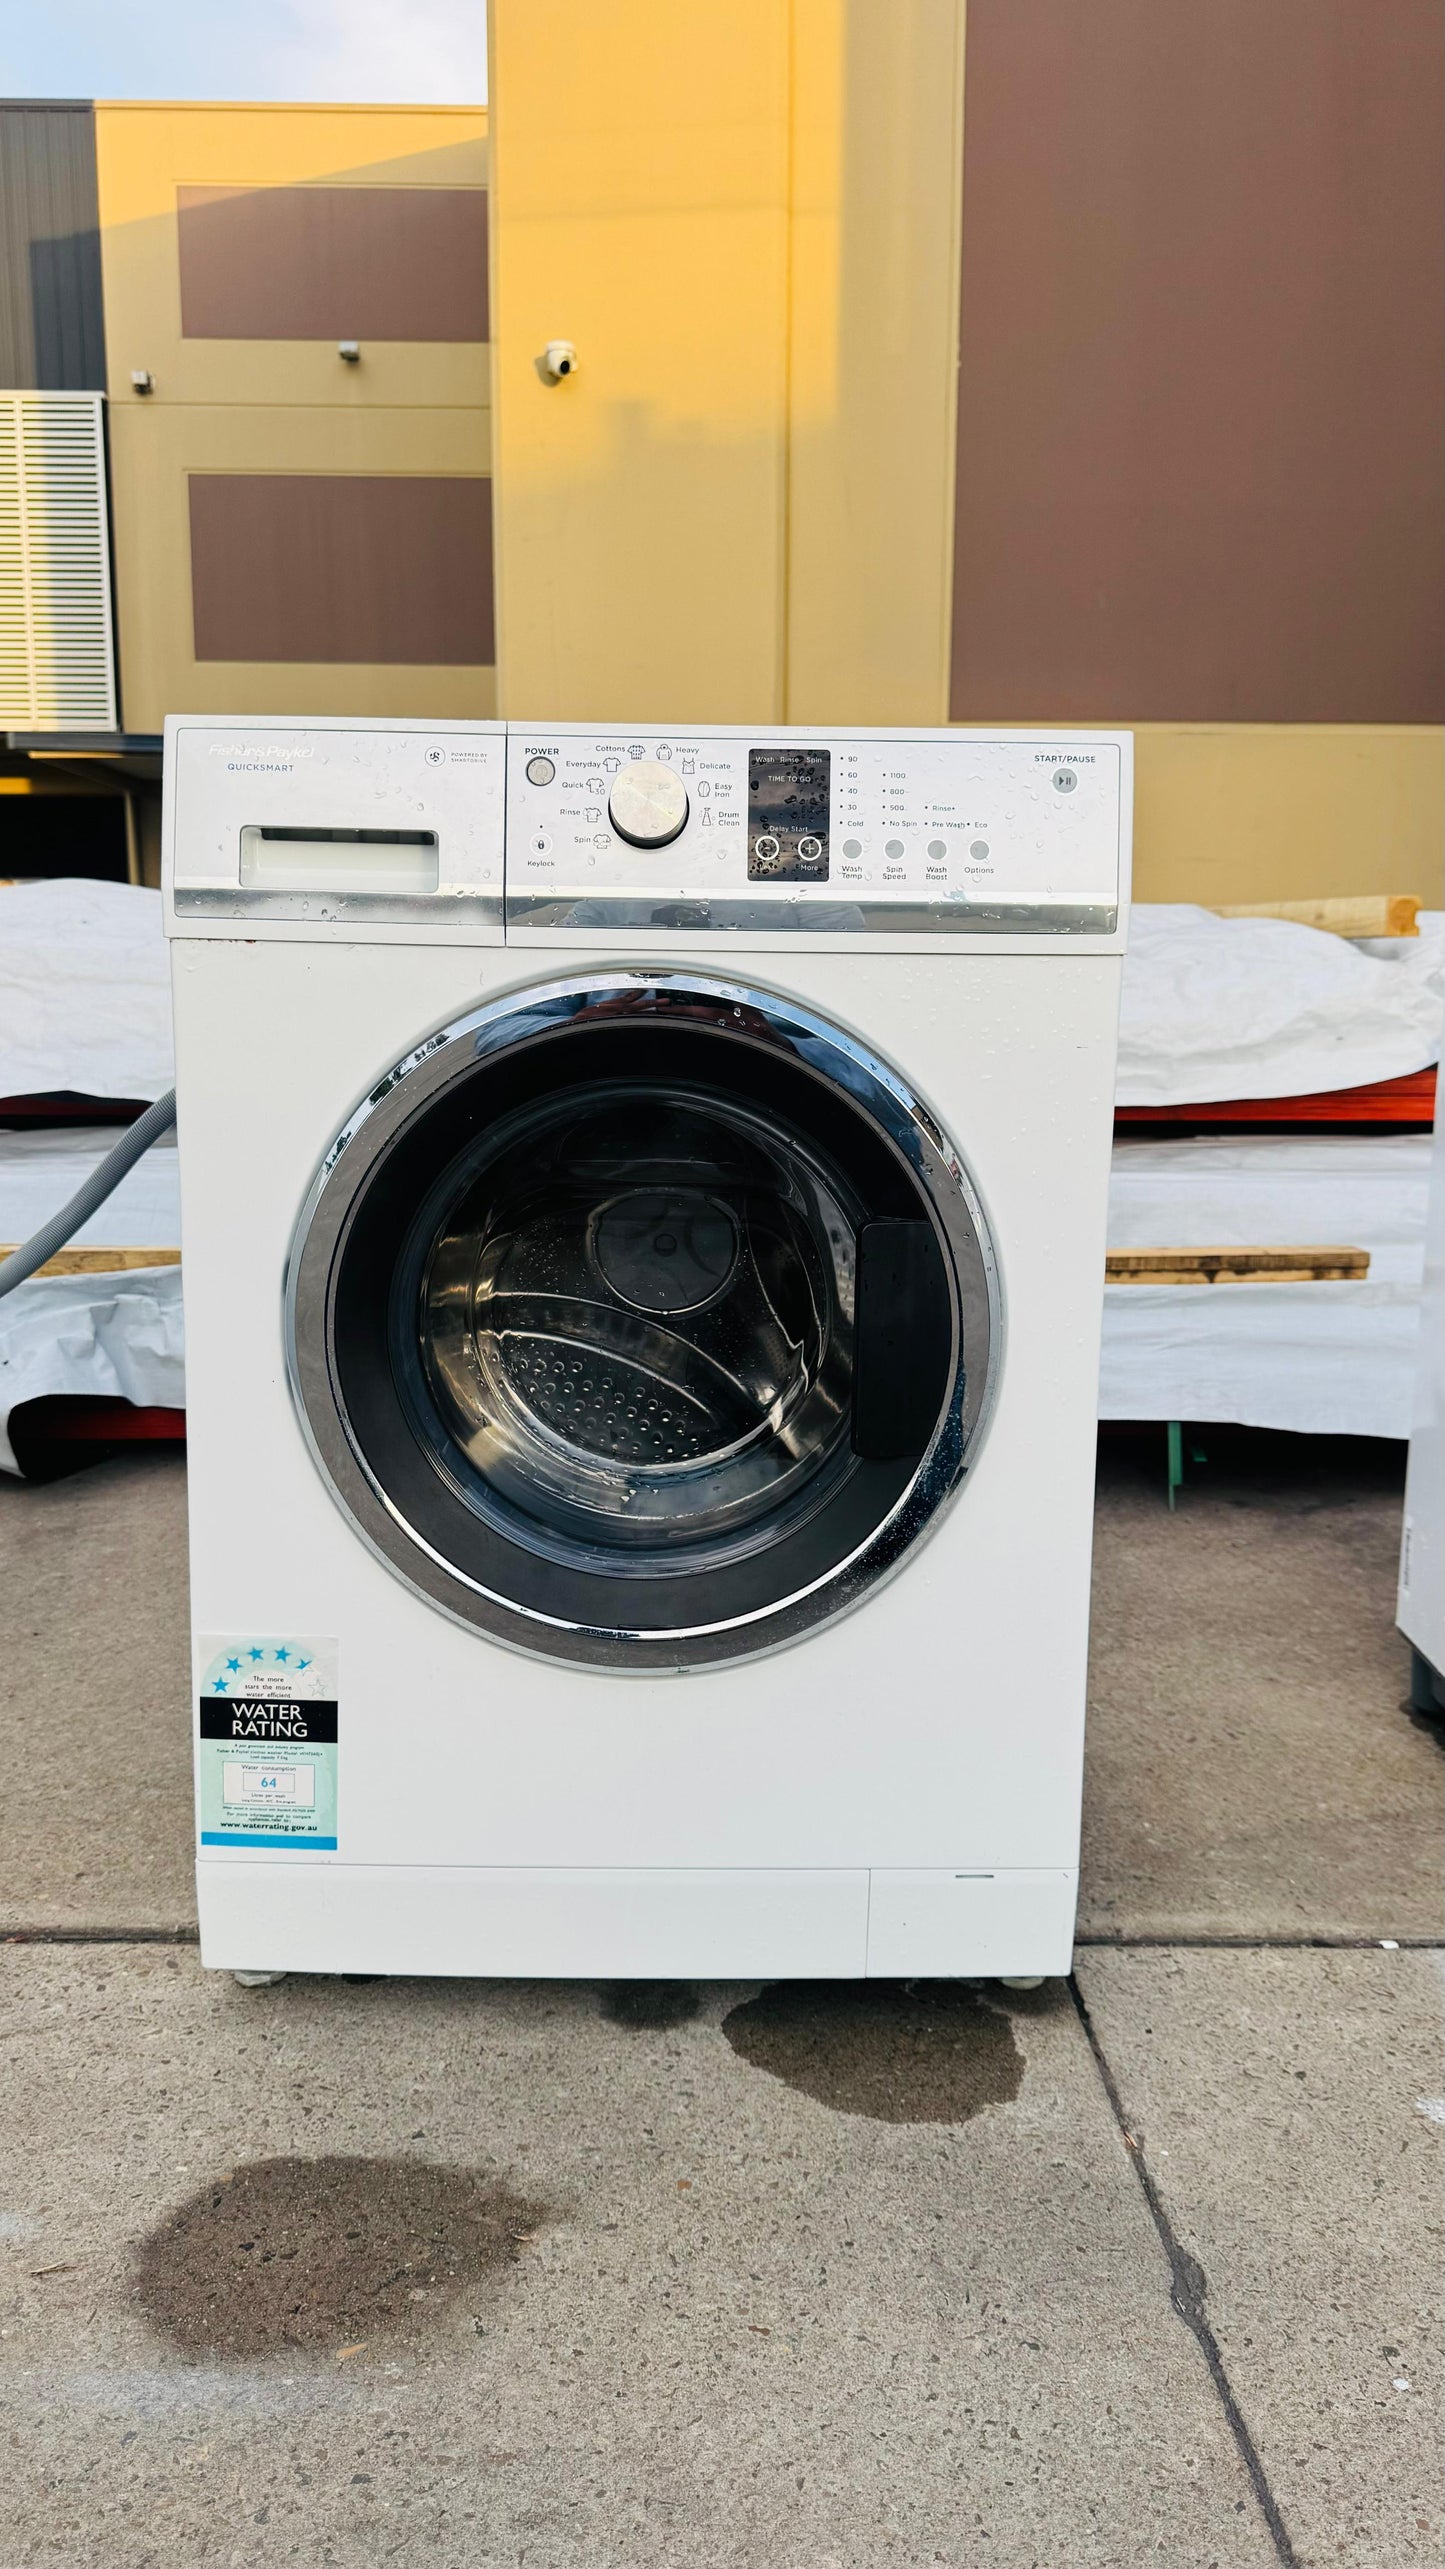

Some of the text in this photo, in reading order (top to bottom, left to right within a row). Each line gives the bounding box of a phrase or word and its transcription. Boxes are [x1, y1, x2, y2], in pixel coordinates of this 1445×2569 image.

[676, 746, 699, 754] Heavy
[1034, 755, 1096, 763] START/PAUSE
[227, 763, 294, 772] QUICKSMART
[566, 760, 601, 768] Everyday
[562, 781, 584, 789] Quick
[715, 783, 733, 791] Easy
[560, 808, 581, 816] Rinse
[718, 819, 740, 827] Clean
[768, 825, 789, 833] Delay
[574, 836, 591, 844] Spin
[527, 859, 555, 868] Keylock
[232, 1702, 303, 1720] WATER
[232, 1720, 308, 1738] RATING
[261, 1777, 277, 1788] 64
[220, 1822, 318, 1832] www.waterrating.gov.au
